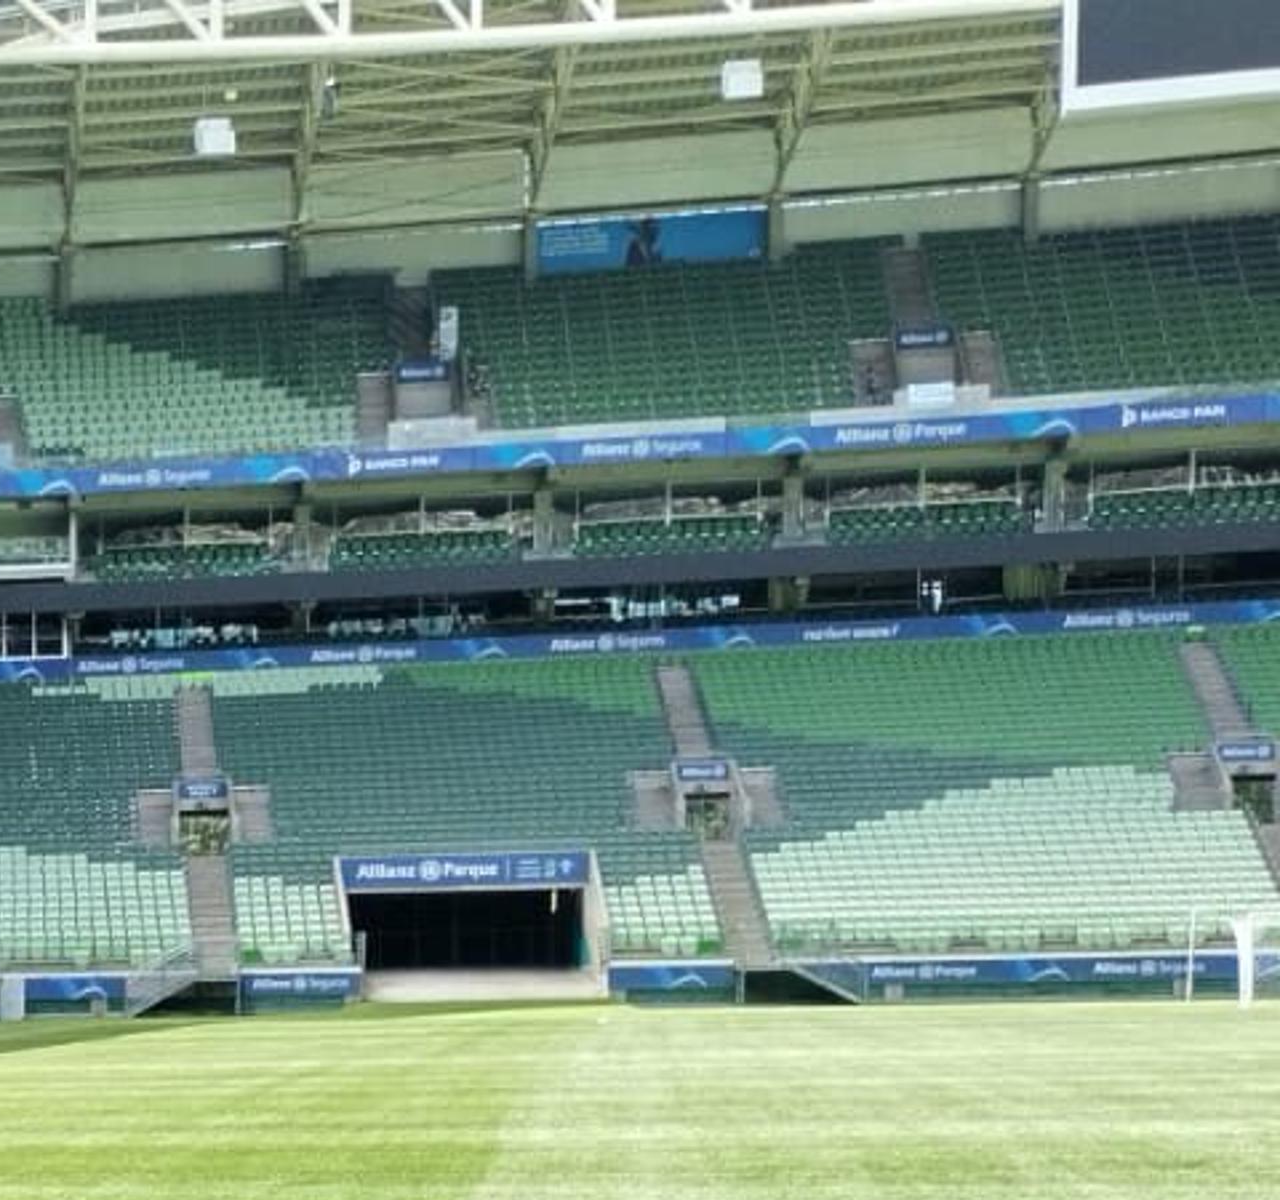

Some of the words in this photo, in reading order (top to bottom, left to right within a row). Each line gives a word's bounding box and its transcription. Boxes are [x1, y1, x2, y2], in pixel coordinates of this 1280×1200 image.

[1141, 406, 1192, 422] BANCO
[1193, 404, 1225, 419] PAN
[836, 428, 890, 443] Allianz
[915, 422, 966, 444] Parque
[582, 443, 631, 458] Allianz
[651, 439, 701, 457] Seguros
[365, 457, 408, 471] BANCO
[411, 454, 439, 467] PAN
[99, 473, 141, 486] Allianz
[164, 468, 211, 485] Seguros
[1063, 613, 1109, 629] Allianz
[1136, 609, 1191, 625] Seguros
[77, 659, 121, 673] Allianz
[140, 657, 184, 673] Seguros
[356, 861, 416, 880] Allianz
[443, 860, 499, 882] Parque
[871, 964, 915, 980] Allianz
[936, 964, 976, 980] Parque
